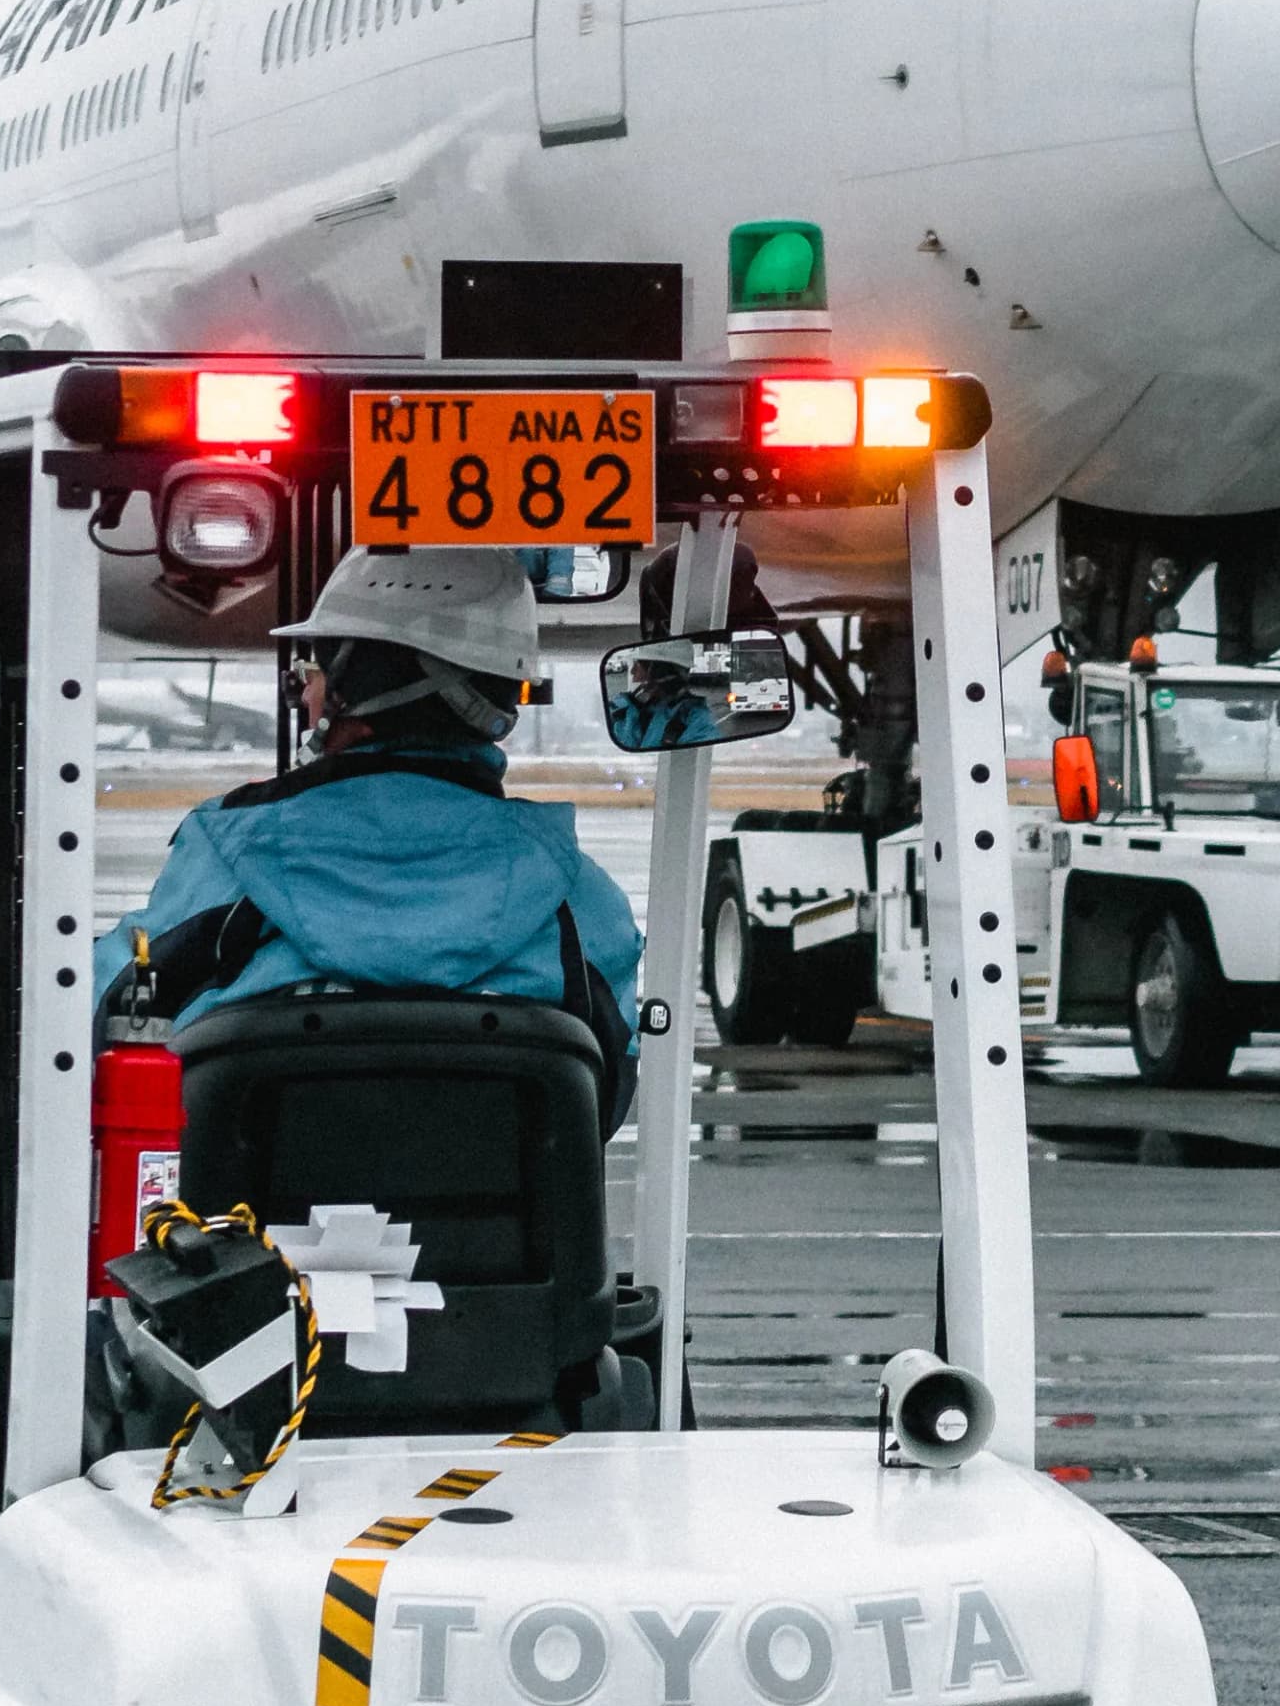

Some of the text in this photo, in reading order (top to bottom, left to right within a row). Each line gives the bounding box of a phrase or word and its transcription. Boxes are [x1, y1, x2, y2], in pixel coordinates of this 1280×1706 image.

[372, 401, 642, 443] RJTT ANA AS
[369, 454, 631, 530] 4882
[1008, 553, 1043, 613] 007
[393, 1590, 1026, 1705] TOYOTA
